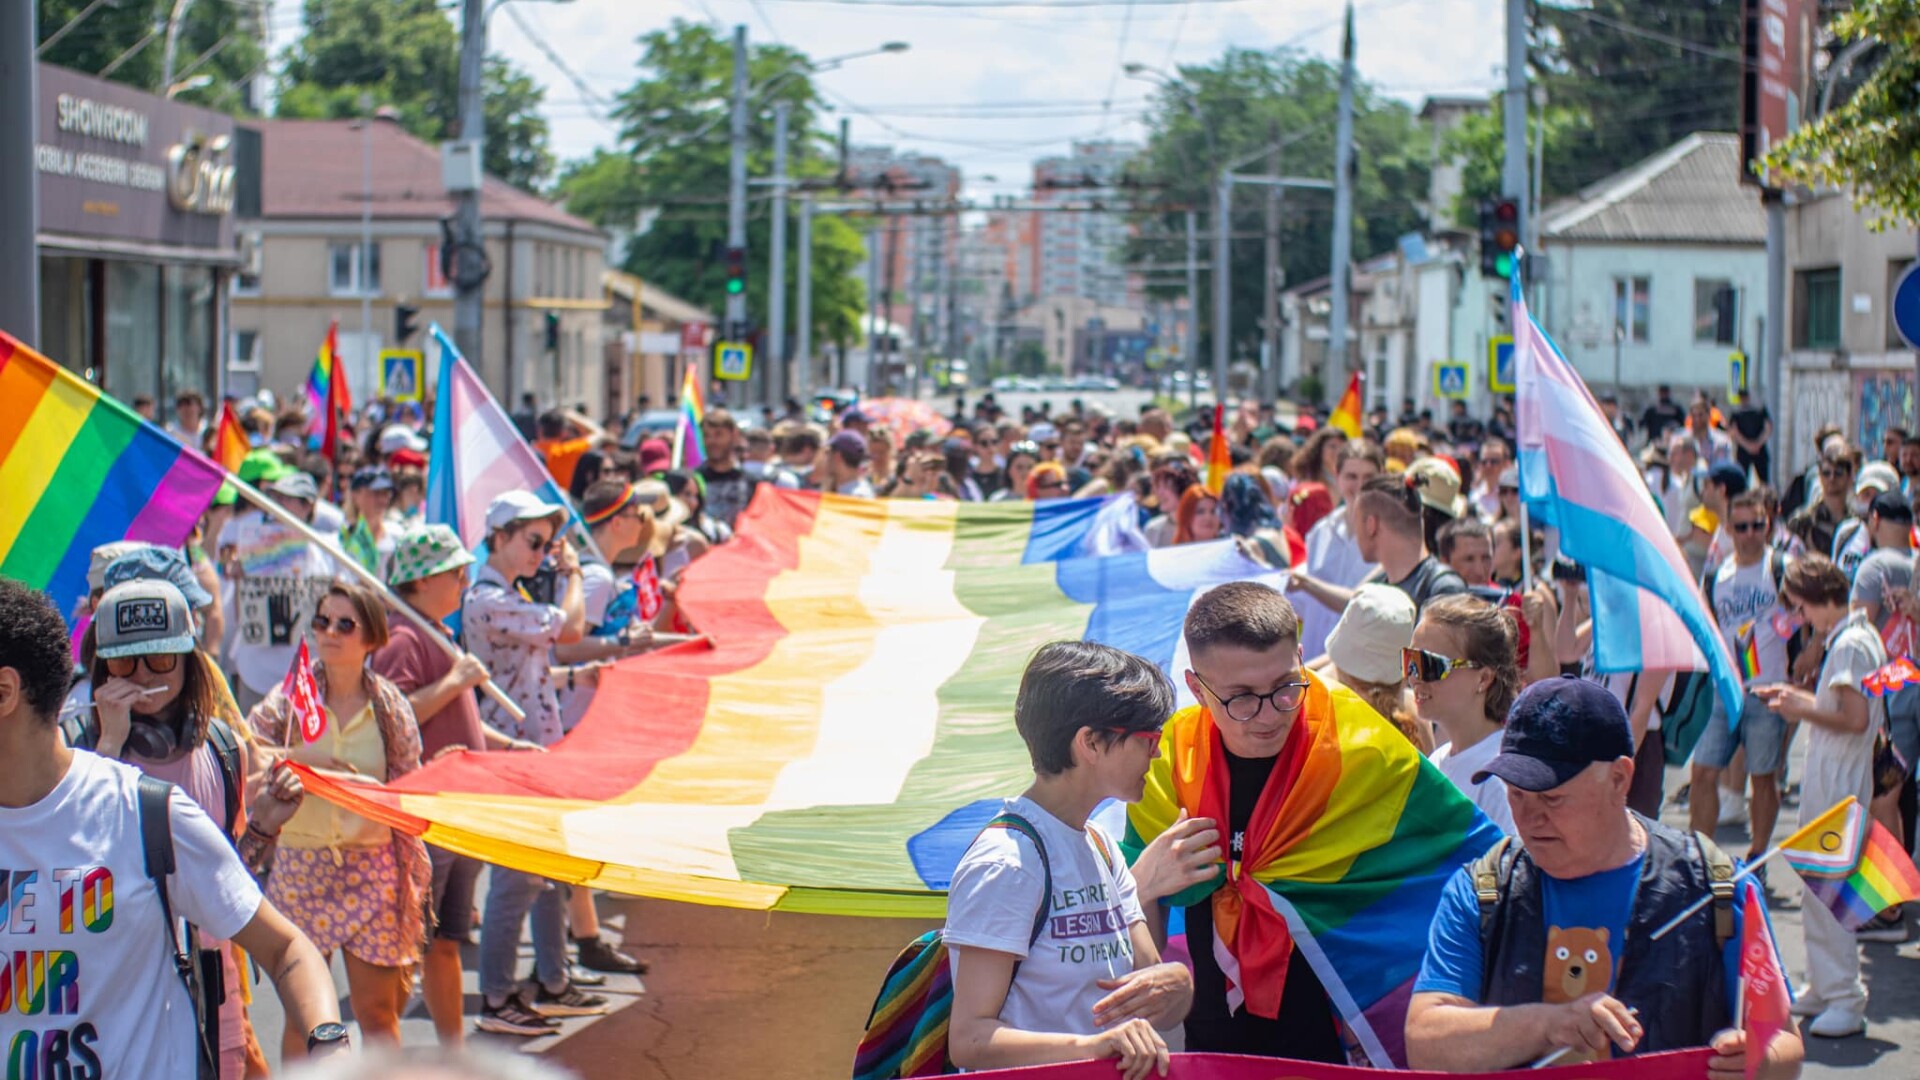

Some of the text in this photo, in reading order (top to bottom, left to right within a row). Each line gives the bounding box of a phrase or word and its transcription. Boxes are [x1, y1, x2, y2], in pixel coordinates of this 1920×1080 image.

[58, 93, 148, 144] SHOWROOM
[1717, 587, 1776, 622] Pacific
[53, 866, 114, 934] TO
[1057, 945, 1085, 963] TO
